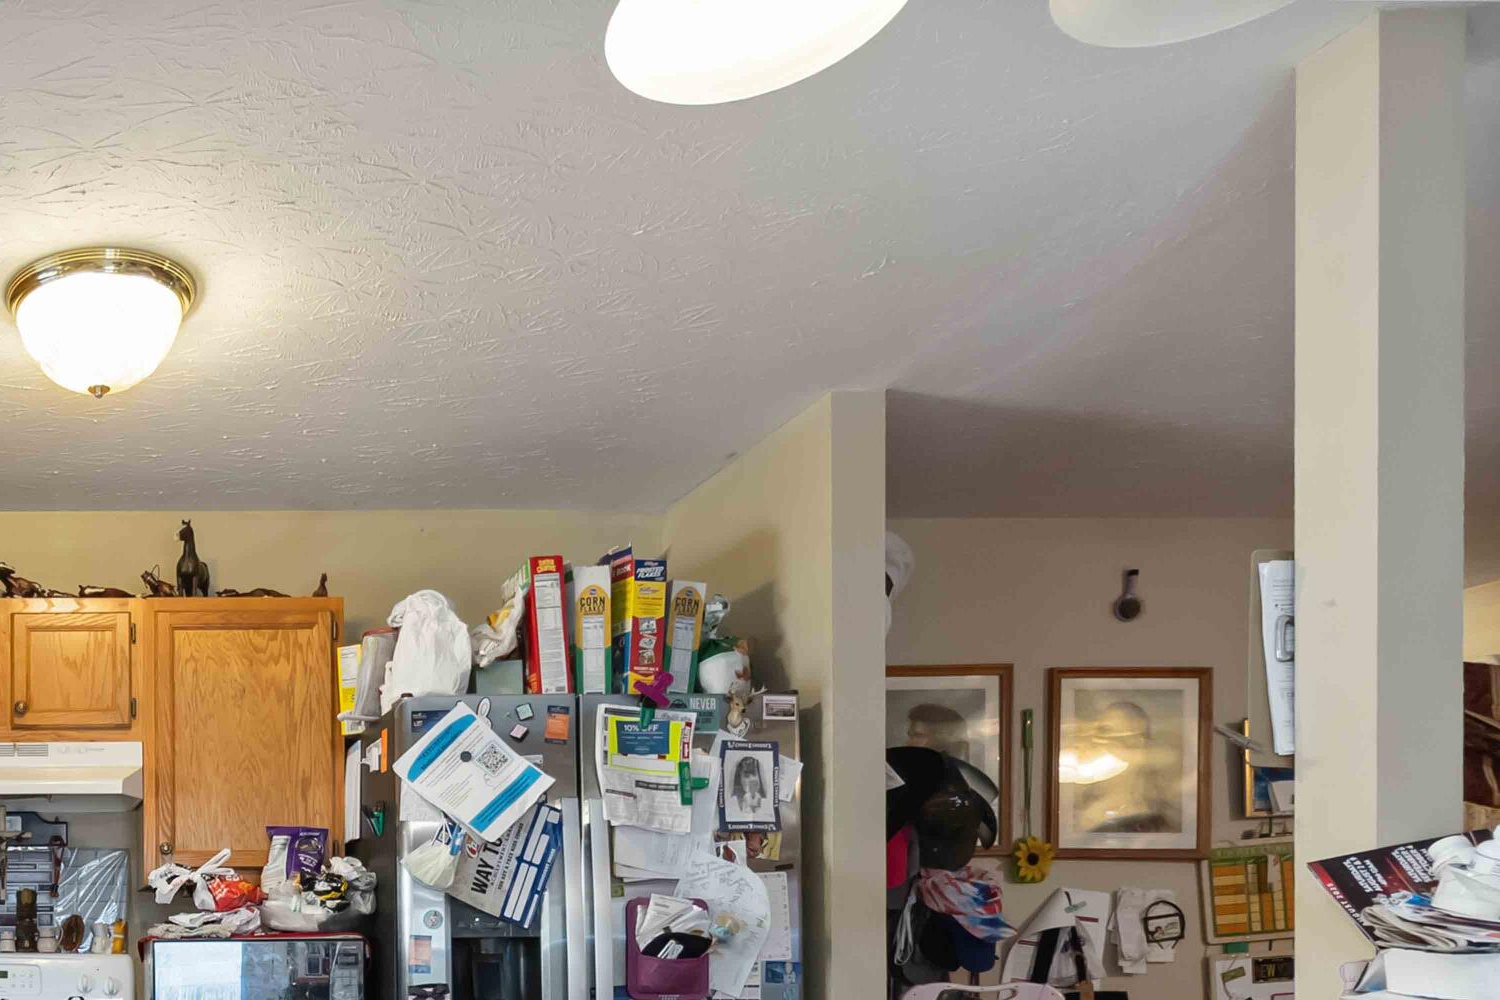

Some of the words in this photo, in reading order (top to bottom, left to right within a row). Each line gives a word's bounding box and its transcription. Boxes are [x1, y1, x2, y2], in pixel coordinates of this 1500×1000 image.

[580, 597, 605, 607] CORN
[676, 597, 700, 607] CORN
[690, 697, 716, 710] NEVER
[624, 724, 639, 732] 10%
[470, 857, 494, 894] WAY
